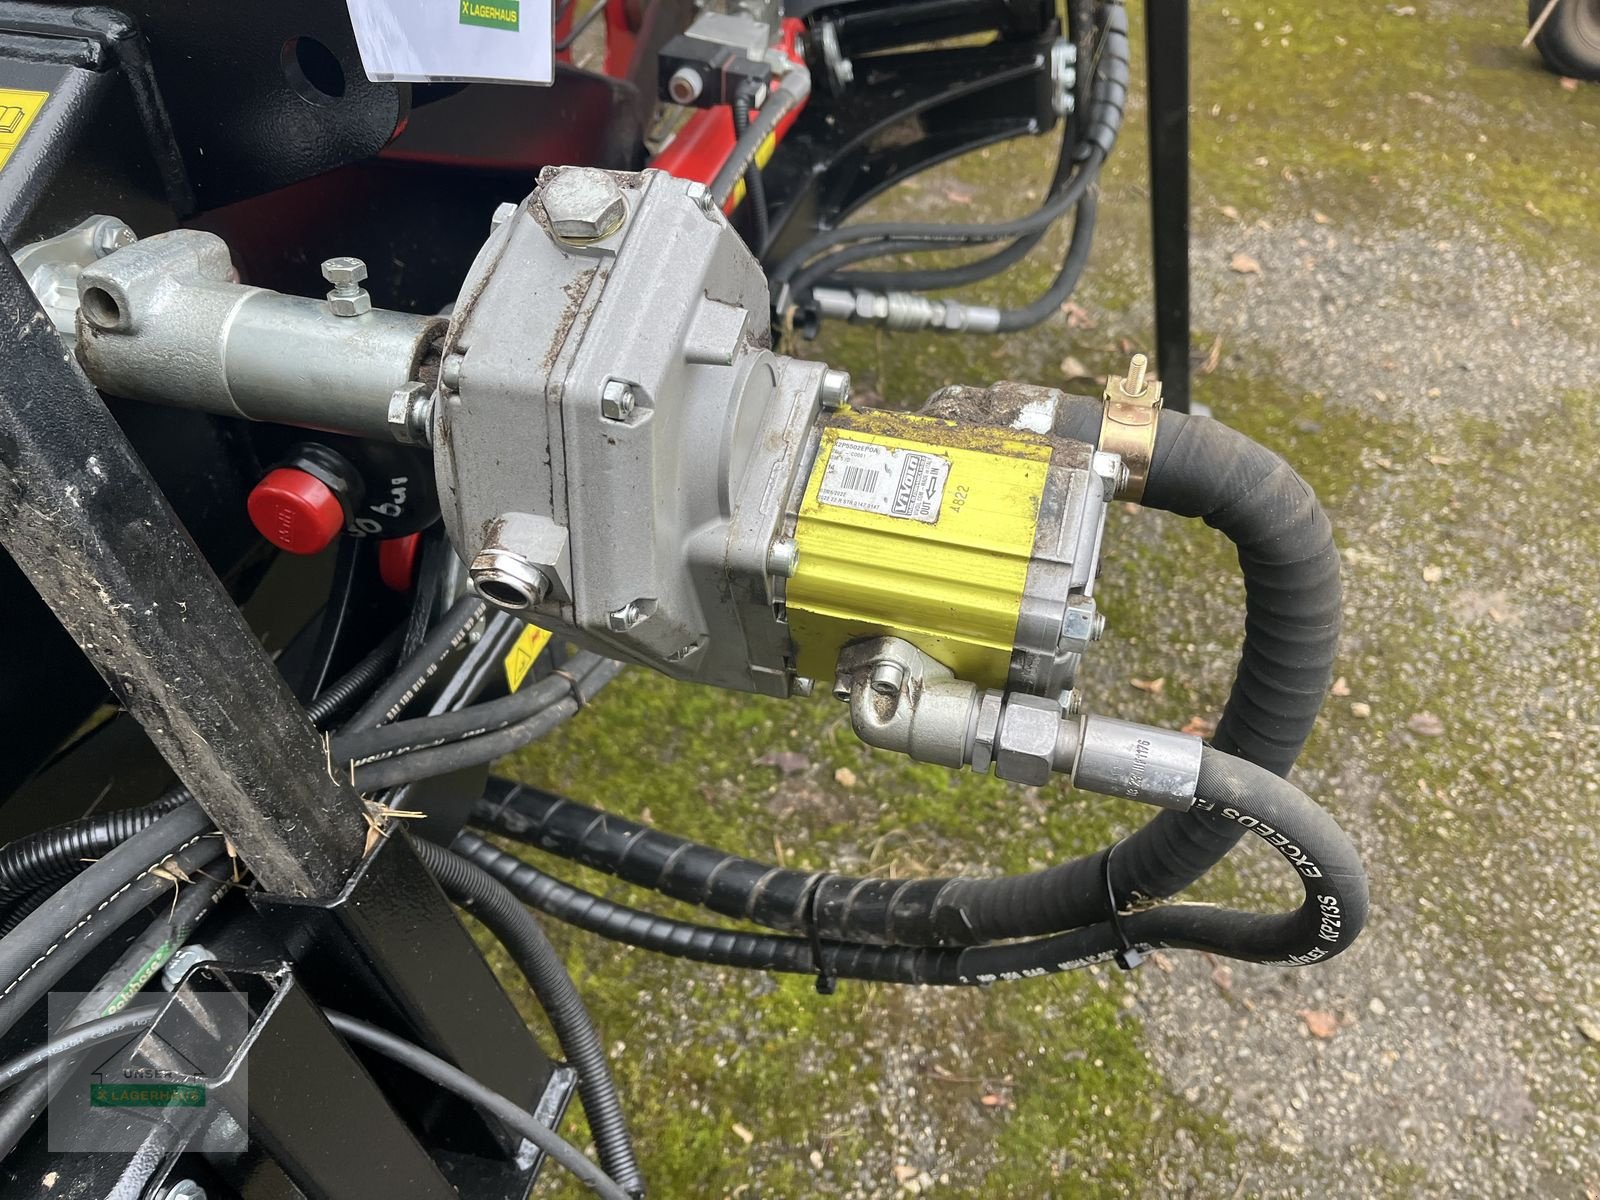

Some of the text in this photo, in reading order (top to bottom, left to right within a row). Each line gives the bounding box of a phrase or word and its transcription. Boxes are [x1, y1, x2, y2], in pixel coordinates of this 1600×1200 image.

[469, 3, 517, 23] LAGERHAUS
[919, 467, 940, 516] OUT IN
[1221, 807, 1323, 879] EXCEEDS
[1316, 894, 1341, 942] KP213S
